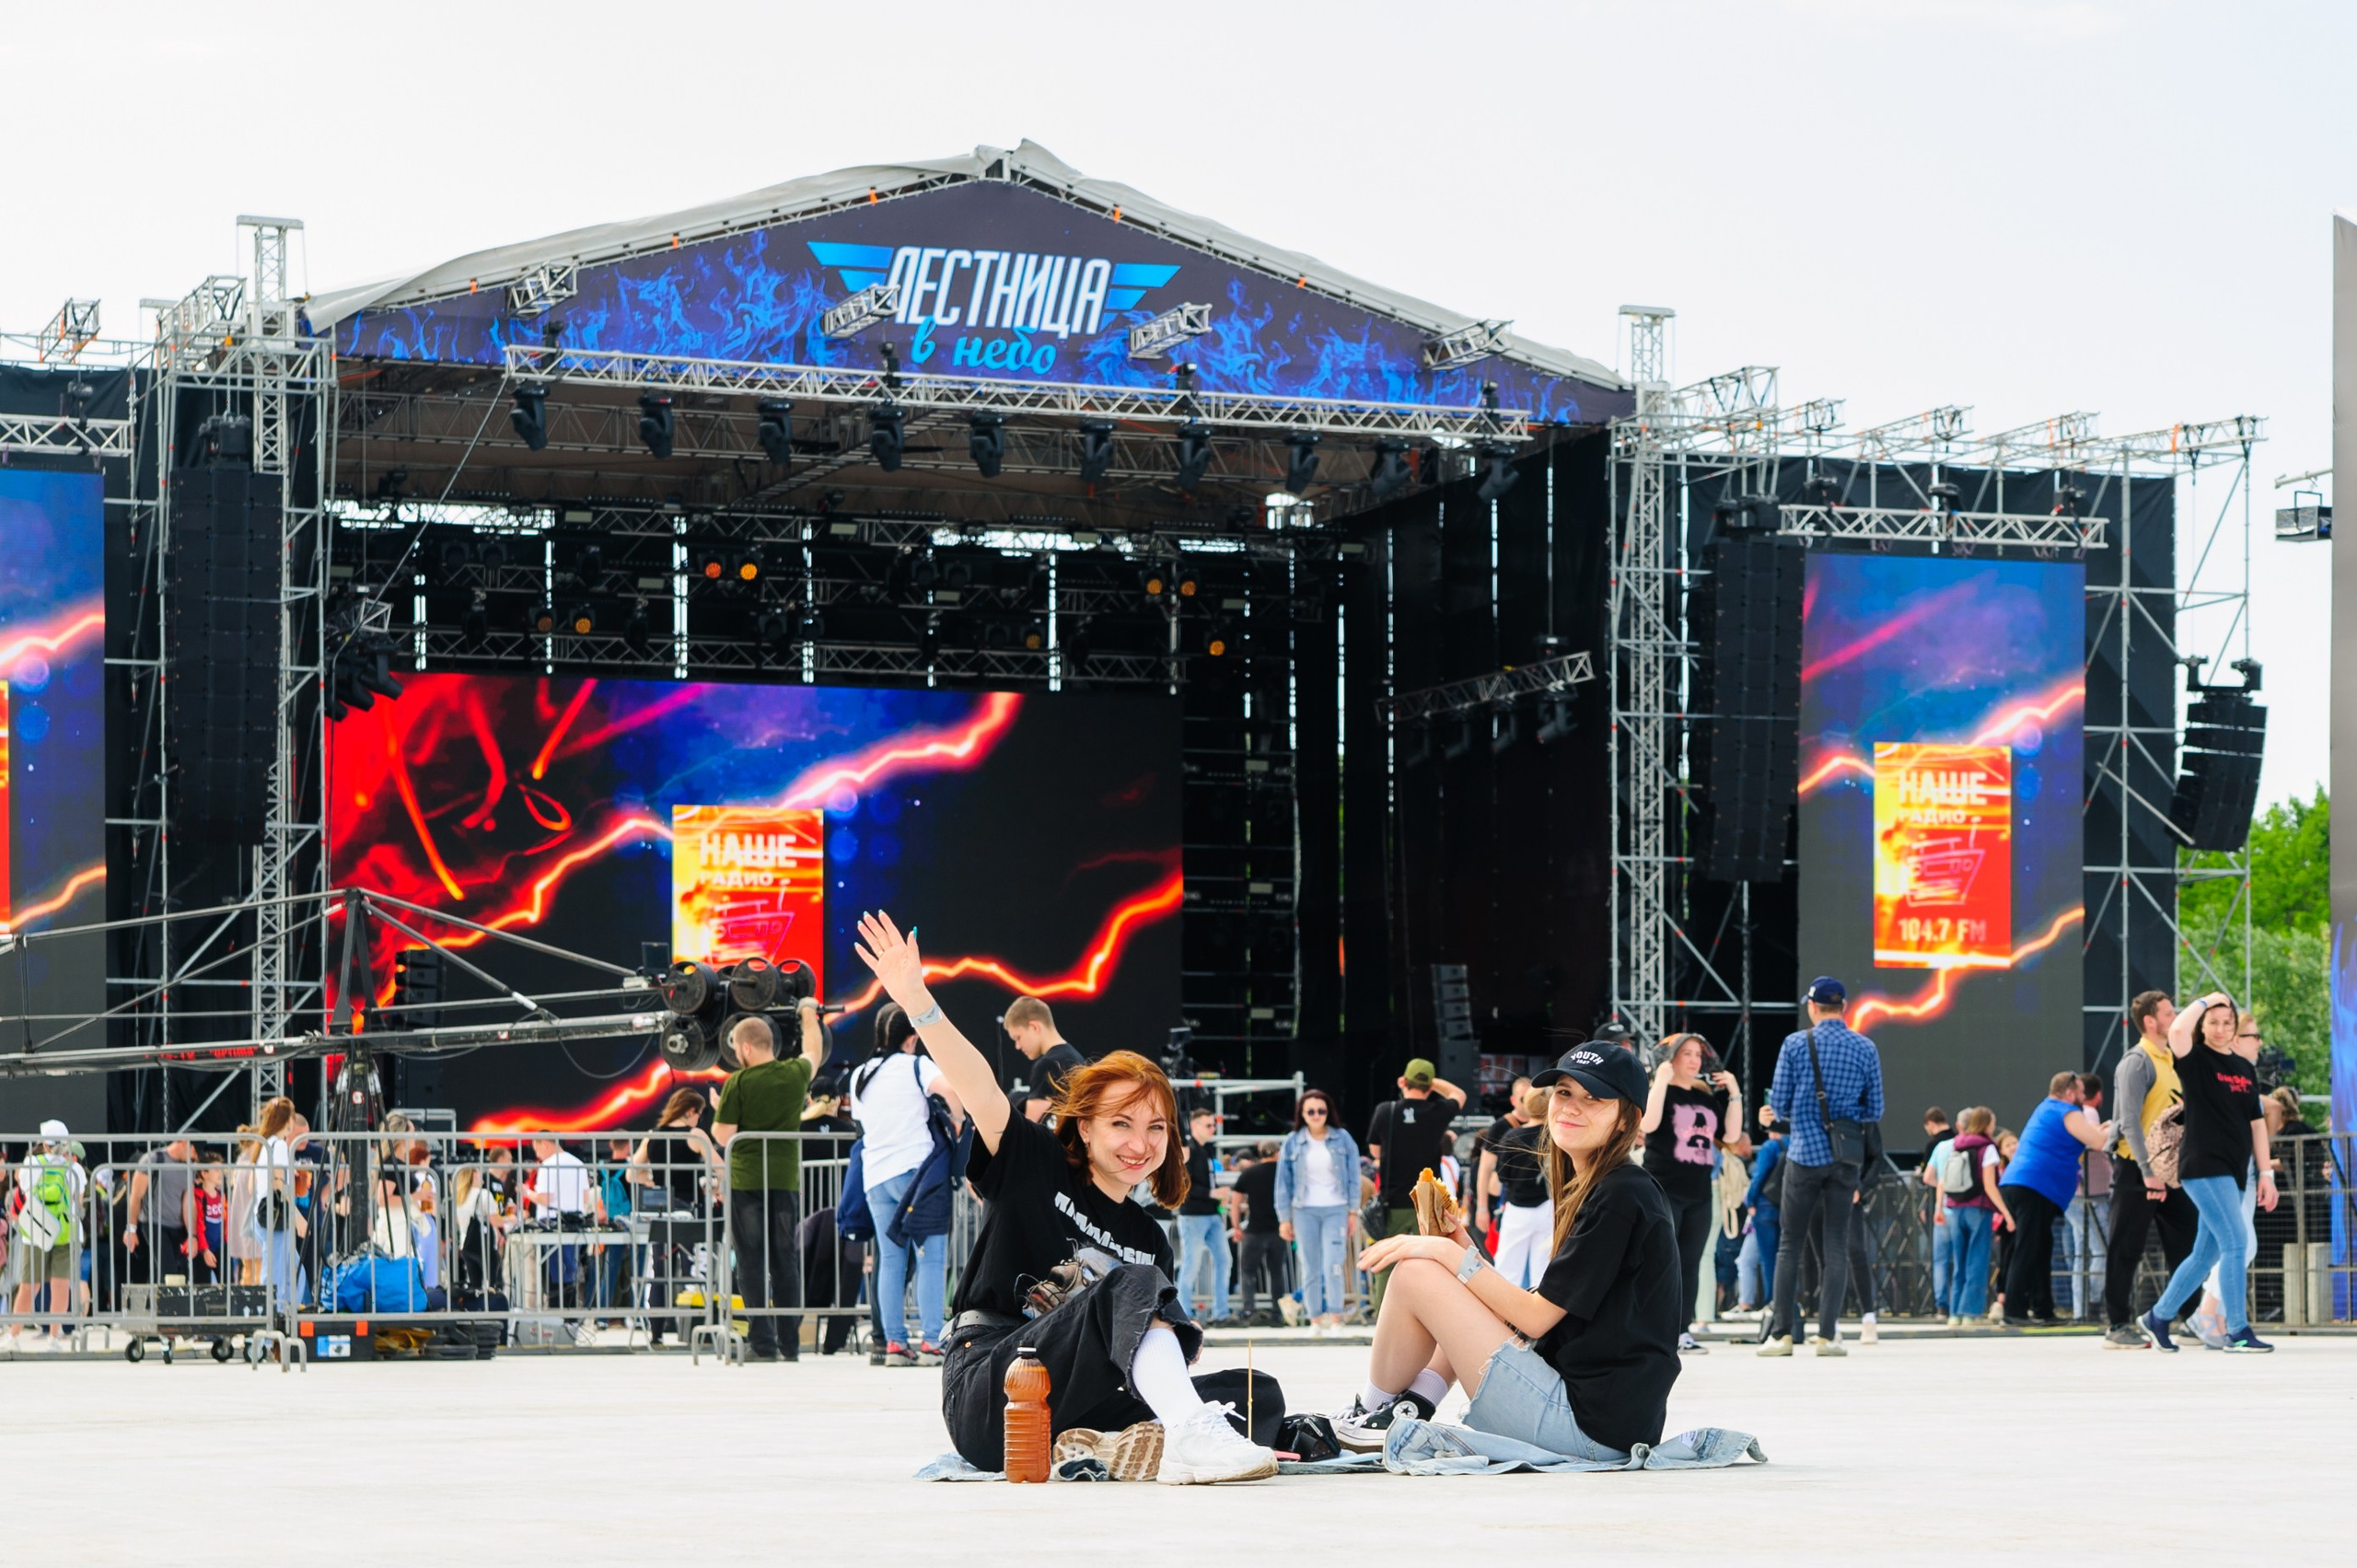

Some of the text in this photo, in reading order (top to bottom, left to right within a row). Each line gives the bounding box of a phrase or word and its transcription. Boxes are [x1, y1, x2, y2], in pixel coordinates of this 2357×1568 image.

[887, 246, 1112, 340] ЛЕСТНИЦА
[911, 315, 1057, 375] в небо
[1898, 771, 1987, 806] НАШЕ
[1898, 808, 1967, 825] РАДИО
[700, 832, 797, 868] НАШЕ
[699, 870, 774, 888] РАДИО
[1898, 917, 1987, 942] 104.7 FM
[1570, 1051, 1604, 1065] YOUTH
